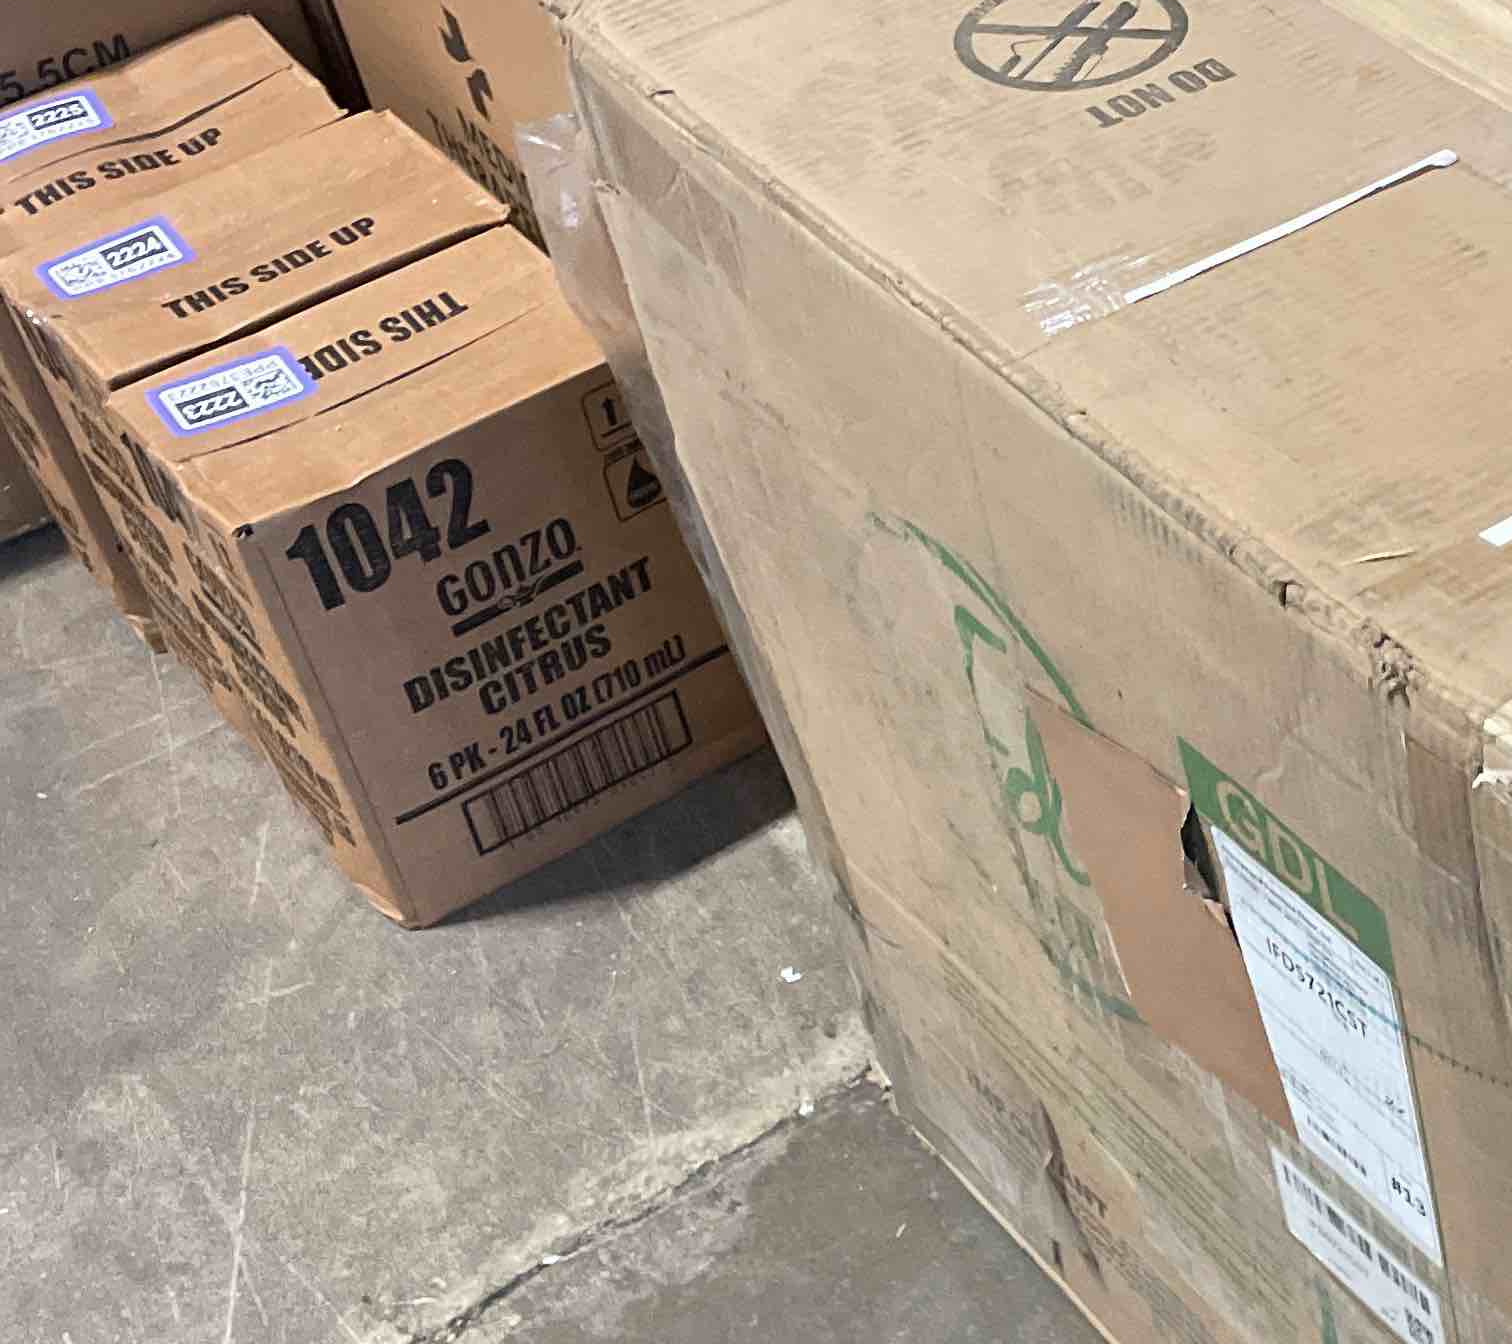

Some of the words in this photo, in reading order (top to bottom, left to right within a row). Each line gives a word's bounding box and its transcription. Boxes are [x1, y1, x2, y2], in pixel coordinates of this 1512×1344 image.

[1084, 82, 1177, 129] NOT
[1166, 56, 1238, 95] DO
[14, 169, 97, 216] THIS
[96, 148, 183, 181] SIDE
[177, 126, 223, 157] UP
[161, 275, 251, 319] THIS
[248, 239, 334, 284] SIDE
[328, 216, 376, 247] UP
[378, 291, 470, 343] THIS
[285, 457, 492, 612] 1042
[401, 556, 656, 715] DISINFECTANT
[478, 623, 613, 716] CITRUS
[428, 762, 449, 790] 6
[447, 742, 487, 781] PK
[499, 718, 533, 755] 24
[532, 703, 561, 737] FL
[560, 685, 593, 721] OZ
